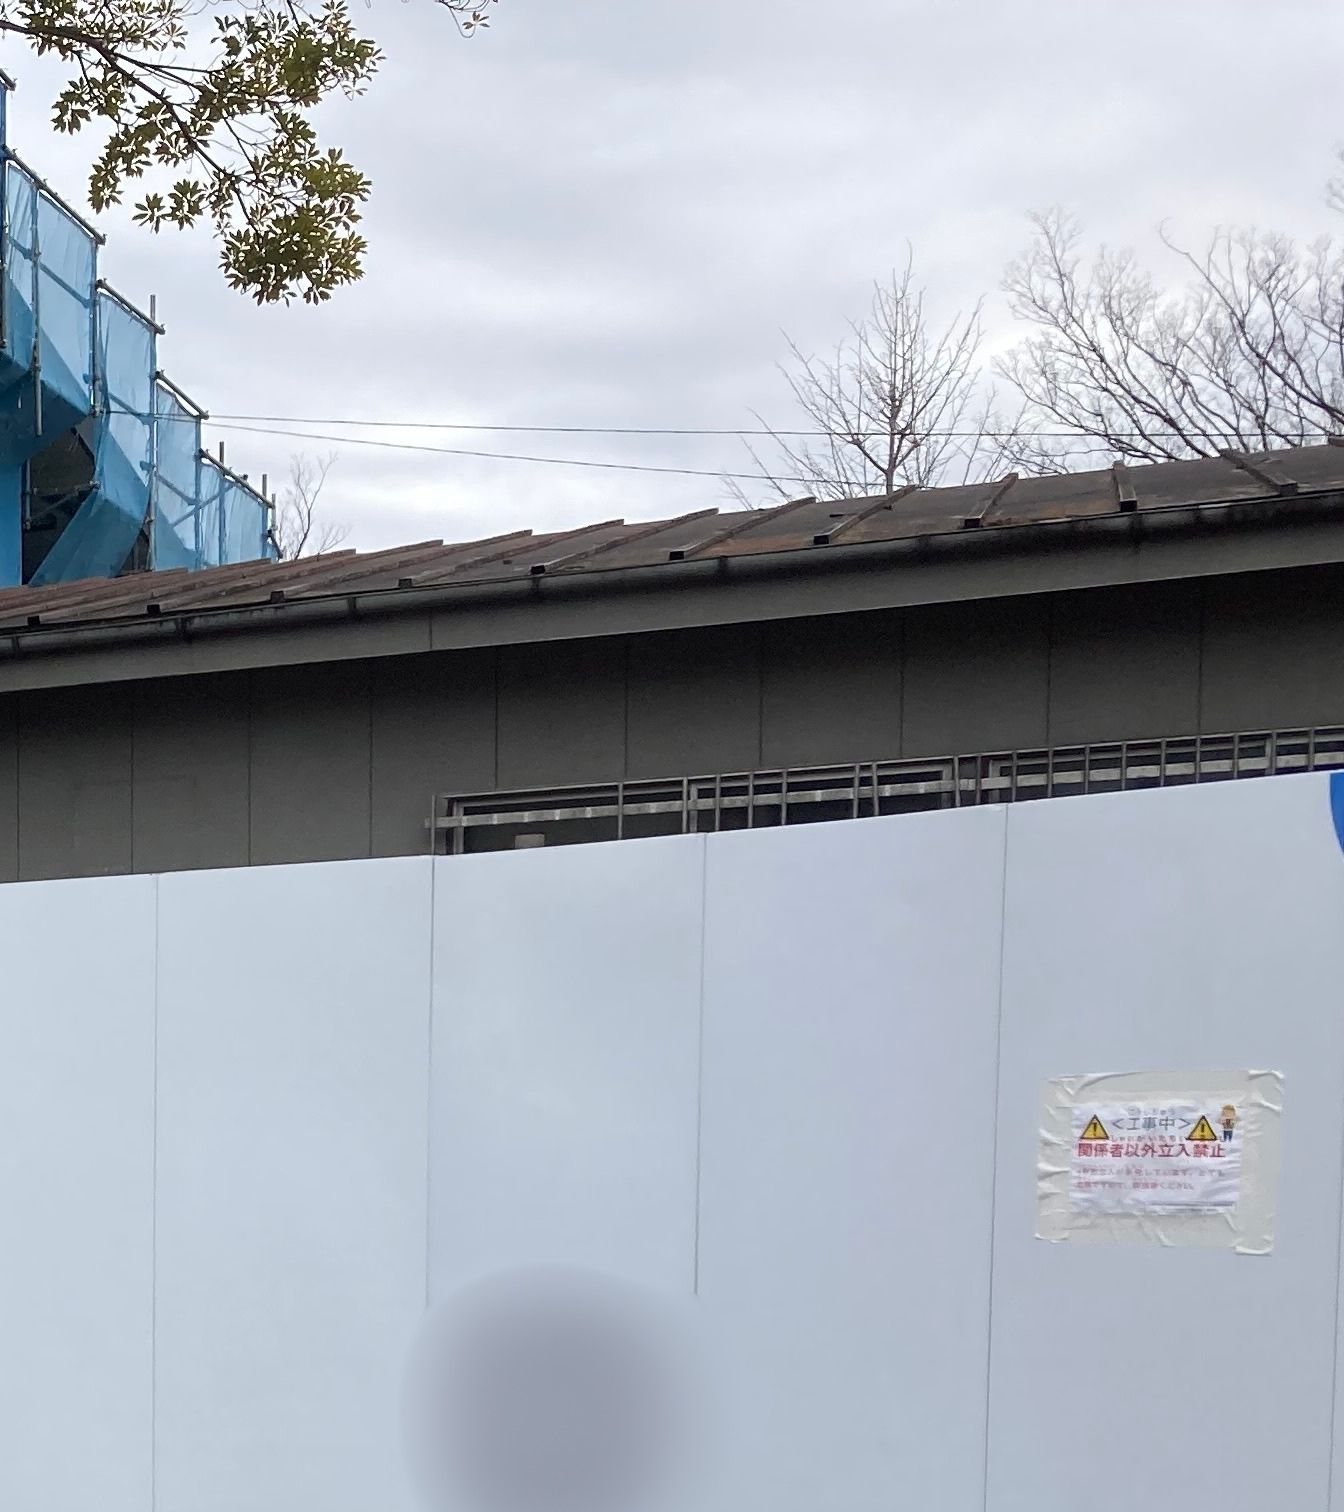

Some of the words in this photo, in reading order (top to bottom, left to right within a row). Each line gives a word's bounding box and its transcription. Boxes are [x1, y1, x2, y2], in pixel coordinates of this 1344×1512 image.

[1077, 1143, 1226, 1158] 関係者以外立入禁止
